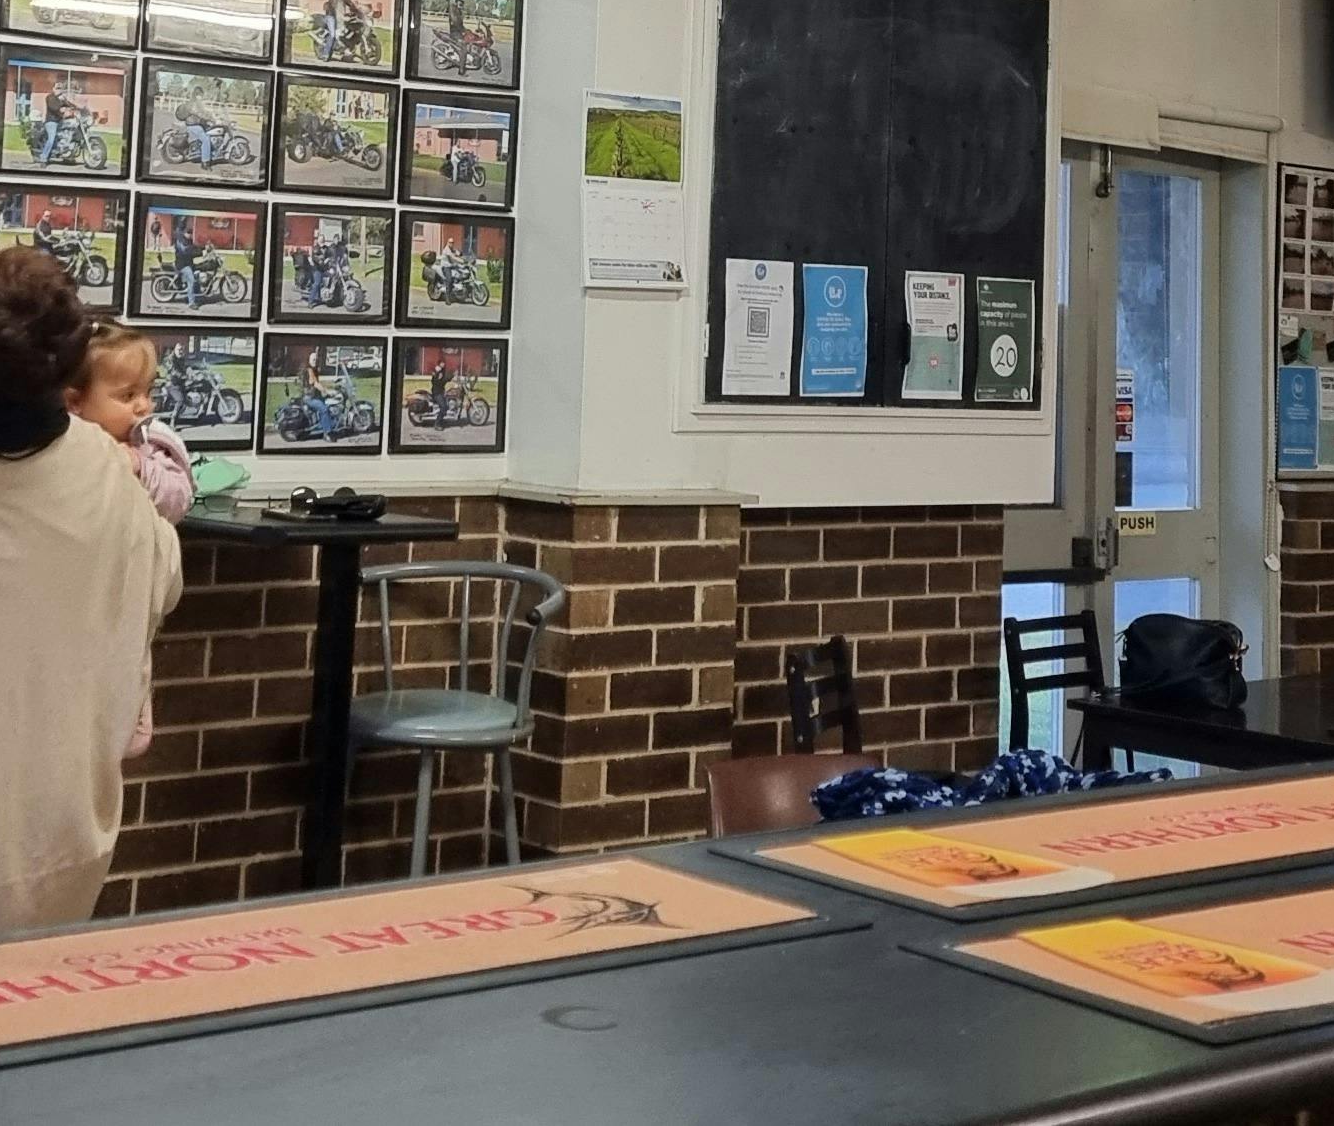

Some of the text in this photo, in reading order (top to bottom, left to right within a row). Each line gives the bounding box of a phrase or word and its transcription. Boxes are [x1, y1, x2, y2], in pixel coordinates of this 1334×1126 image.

[994, 346, 1017, 368] 20
[1117, 385, 1132, 395] VISA
[1120, 516, 1155, 530] PUSH
[1040, 807, 1313, 857] NORTHERN
[133, 925, 303, 956] BREWING
[321, 908, 559, 955] GREAT
